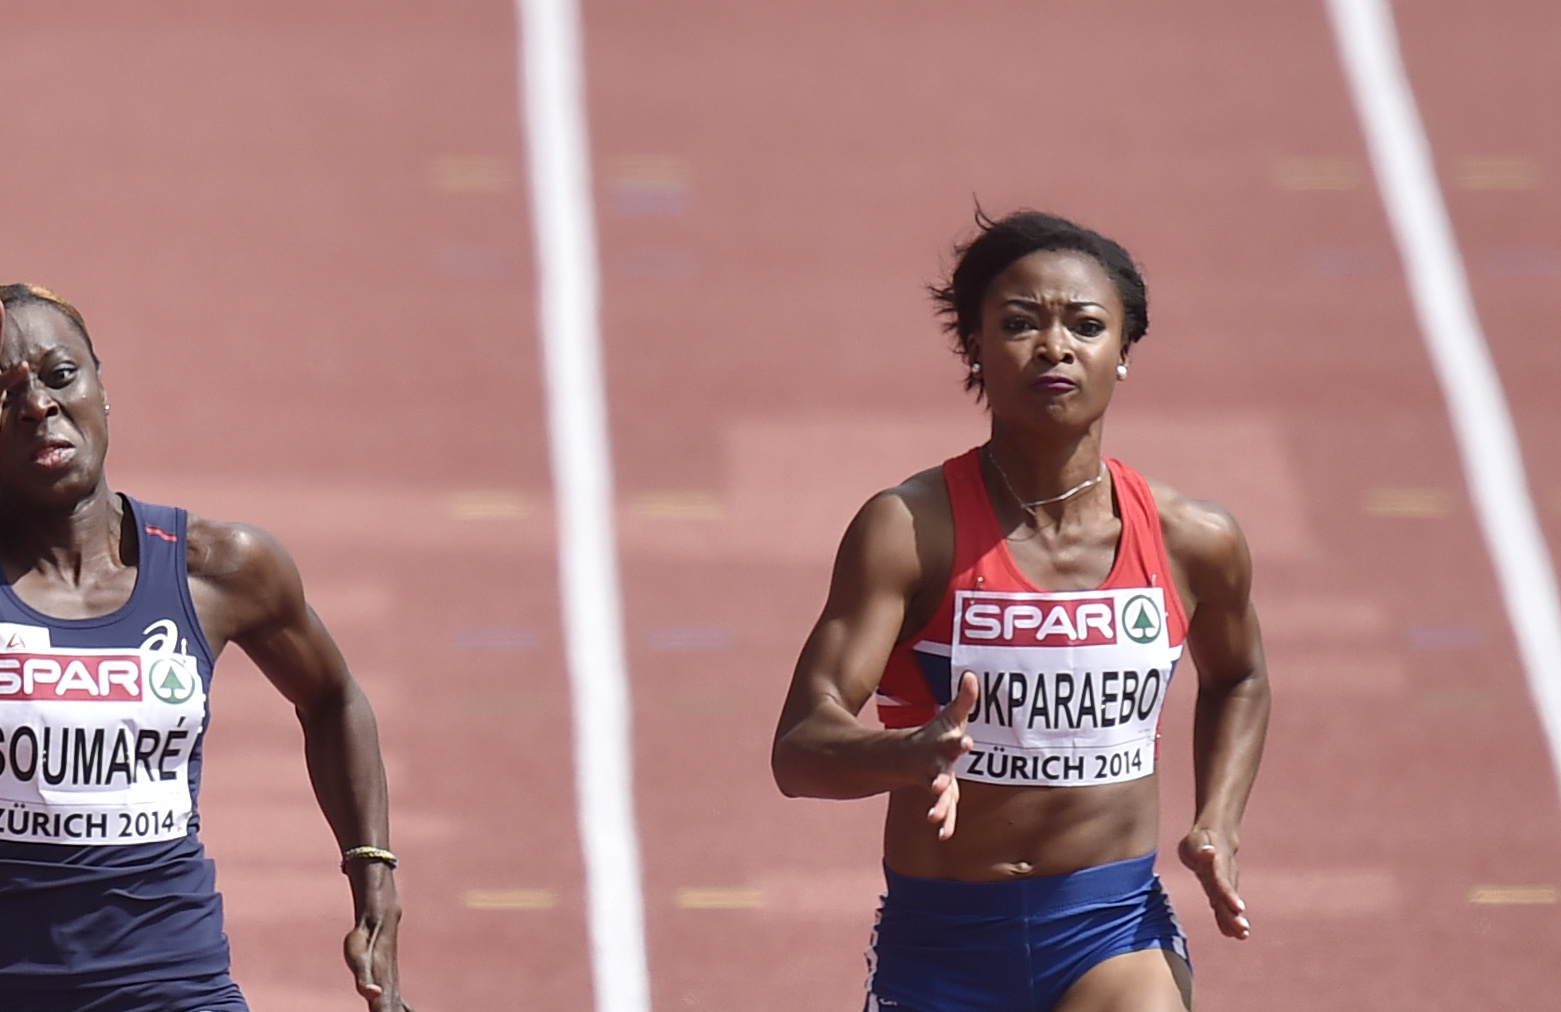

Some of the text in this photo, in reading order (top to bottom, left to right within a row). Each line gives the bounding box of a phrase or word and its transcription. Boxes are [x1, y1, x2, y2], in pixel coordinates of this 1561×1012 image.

[963, 603, 1114, 641] SPAR
[967, 746, 1143, 780] ZÜRICH 2014
[118, 810, 175, 837] 2014
